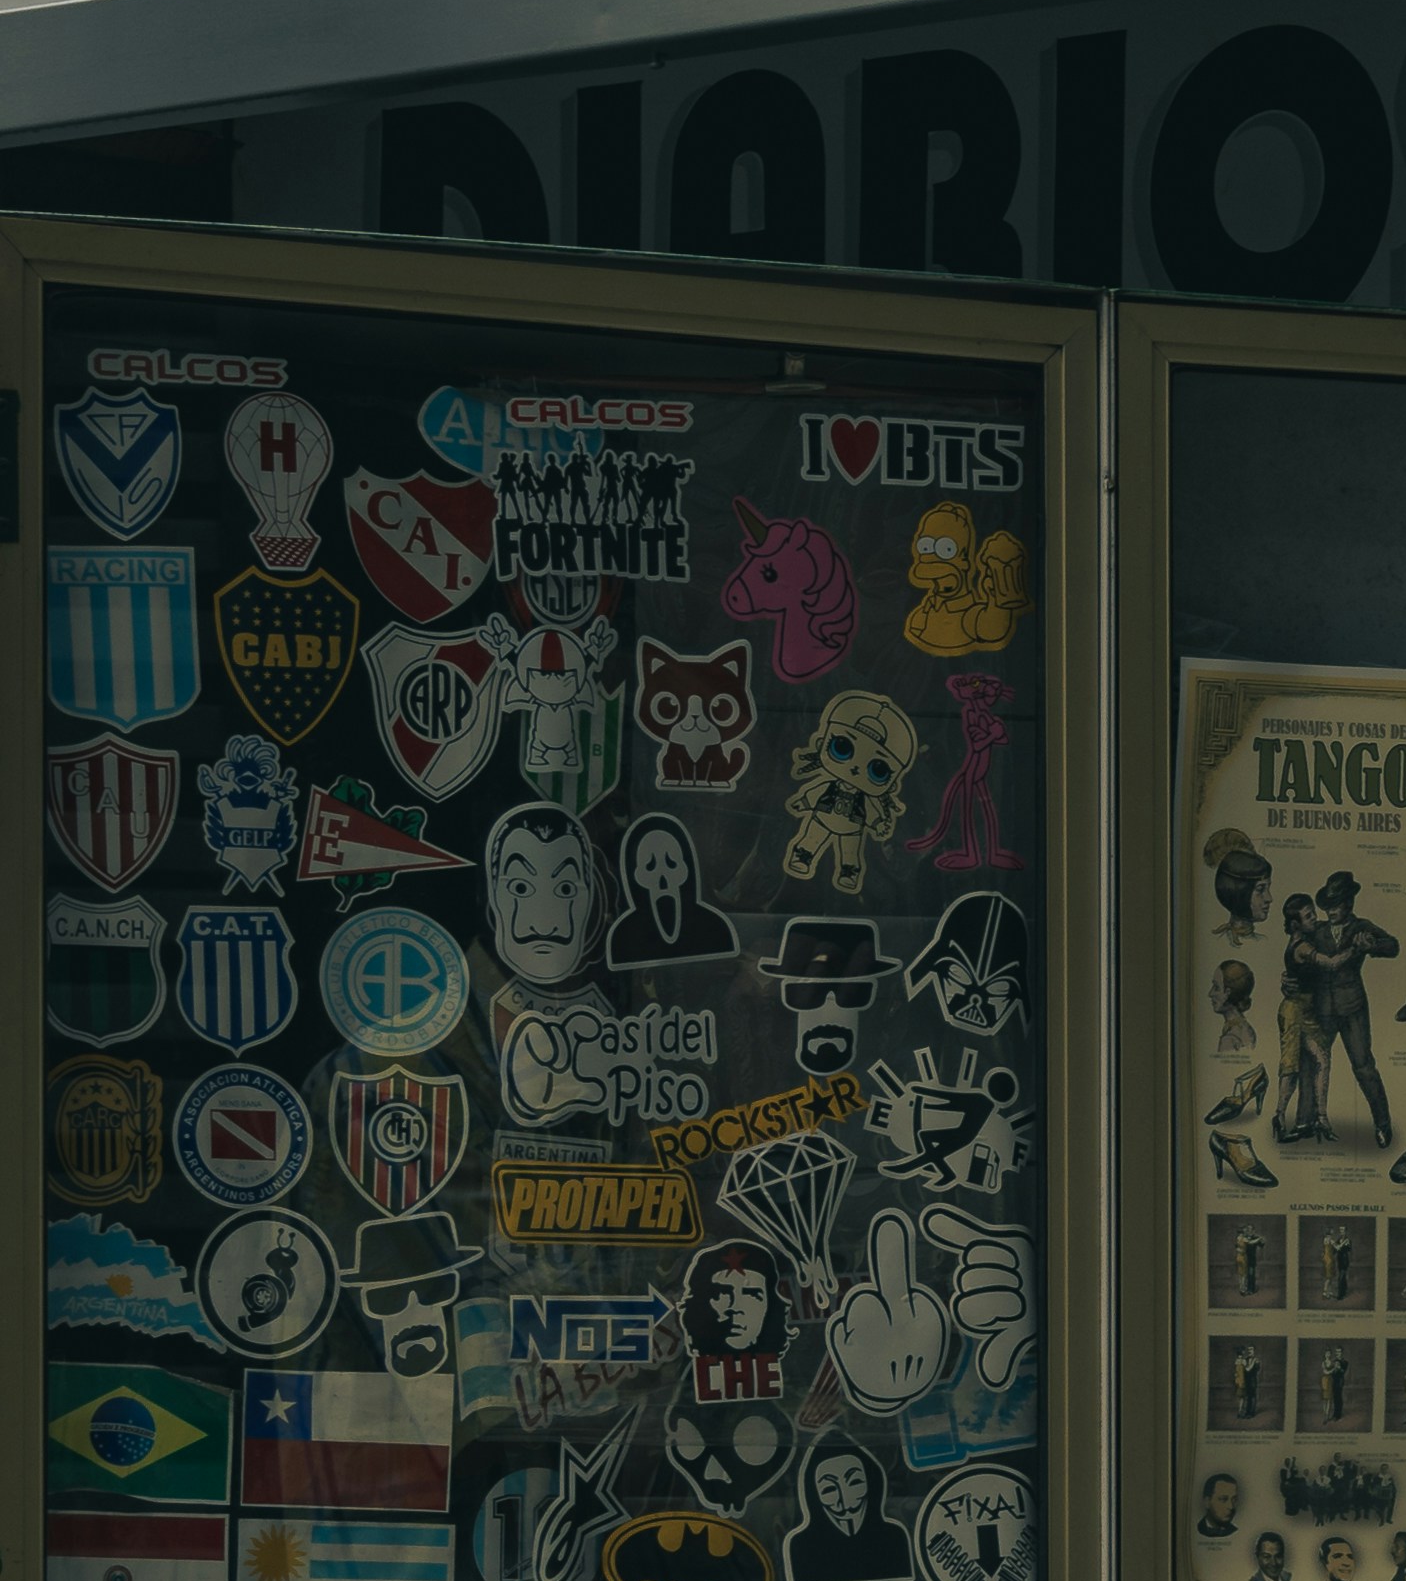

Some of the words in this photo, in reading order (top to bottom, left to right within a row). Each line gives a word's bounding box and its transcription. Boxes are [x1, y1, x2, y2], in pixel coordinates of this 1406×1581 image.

[93, 352, 285, 385] CALCOS
[511, 399, 689, 427] CALCOS
[260, 422, 297, 472] H
[887, 422, 1023, 489] BTS
[496, 519, 685, 579] FORTNITE
[57, 559, 180, 582] RACING
[232, 633, 341, 668] CABJ
[1262, 718, 1333, 737] PERSONAJES
[1337, 722, 1344, 737] Y
[1349, 722, 1387, 739] COSAS
[1267, 809, 1288, 828] DE
[1293, 810, 1352, 831] BUENOS
[1356, 813, 1402, 833] AIRES
[229, 828, 274, 847] GELP
[193, 917, 273, 935] C.A.T.
[503, 1143, 599, 1164] ARGENTINA
[510, 1177, 687, 1232] PROTAPER
[1289, 1203, 1321, 1212] ALGUNOS
[698, 1355, 782, 1401] CHE
